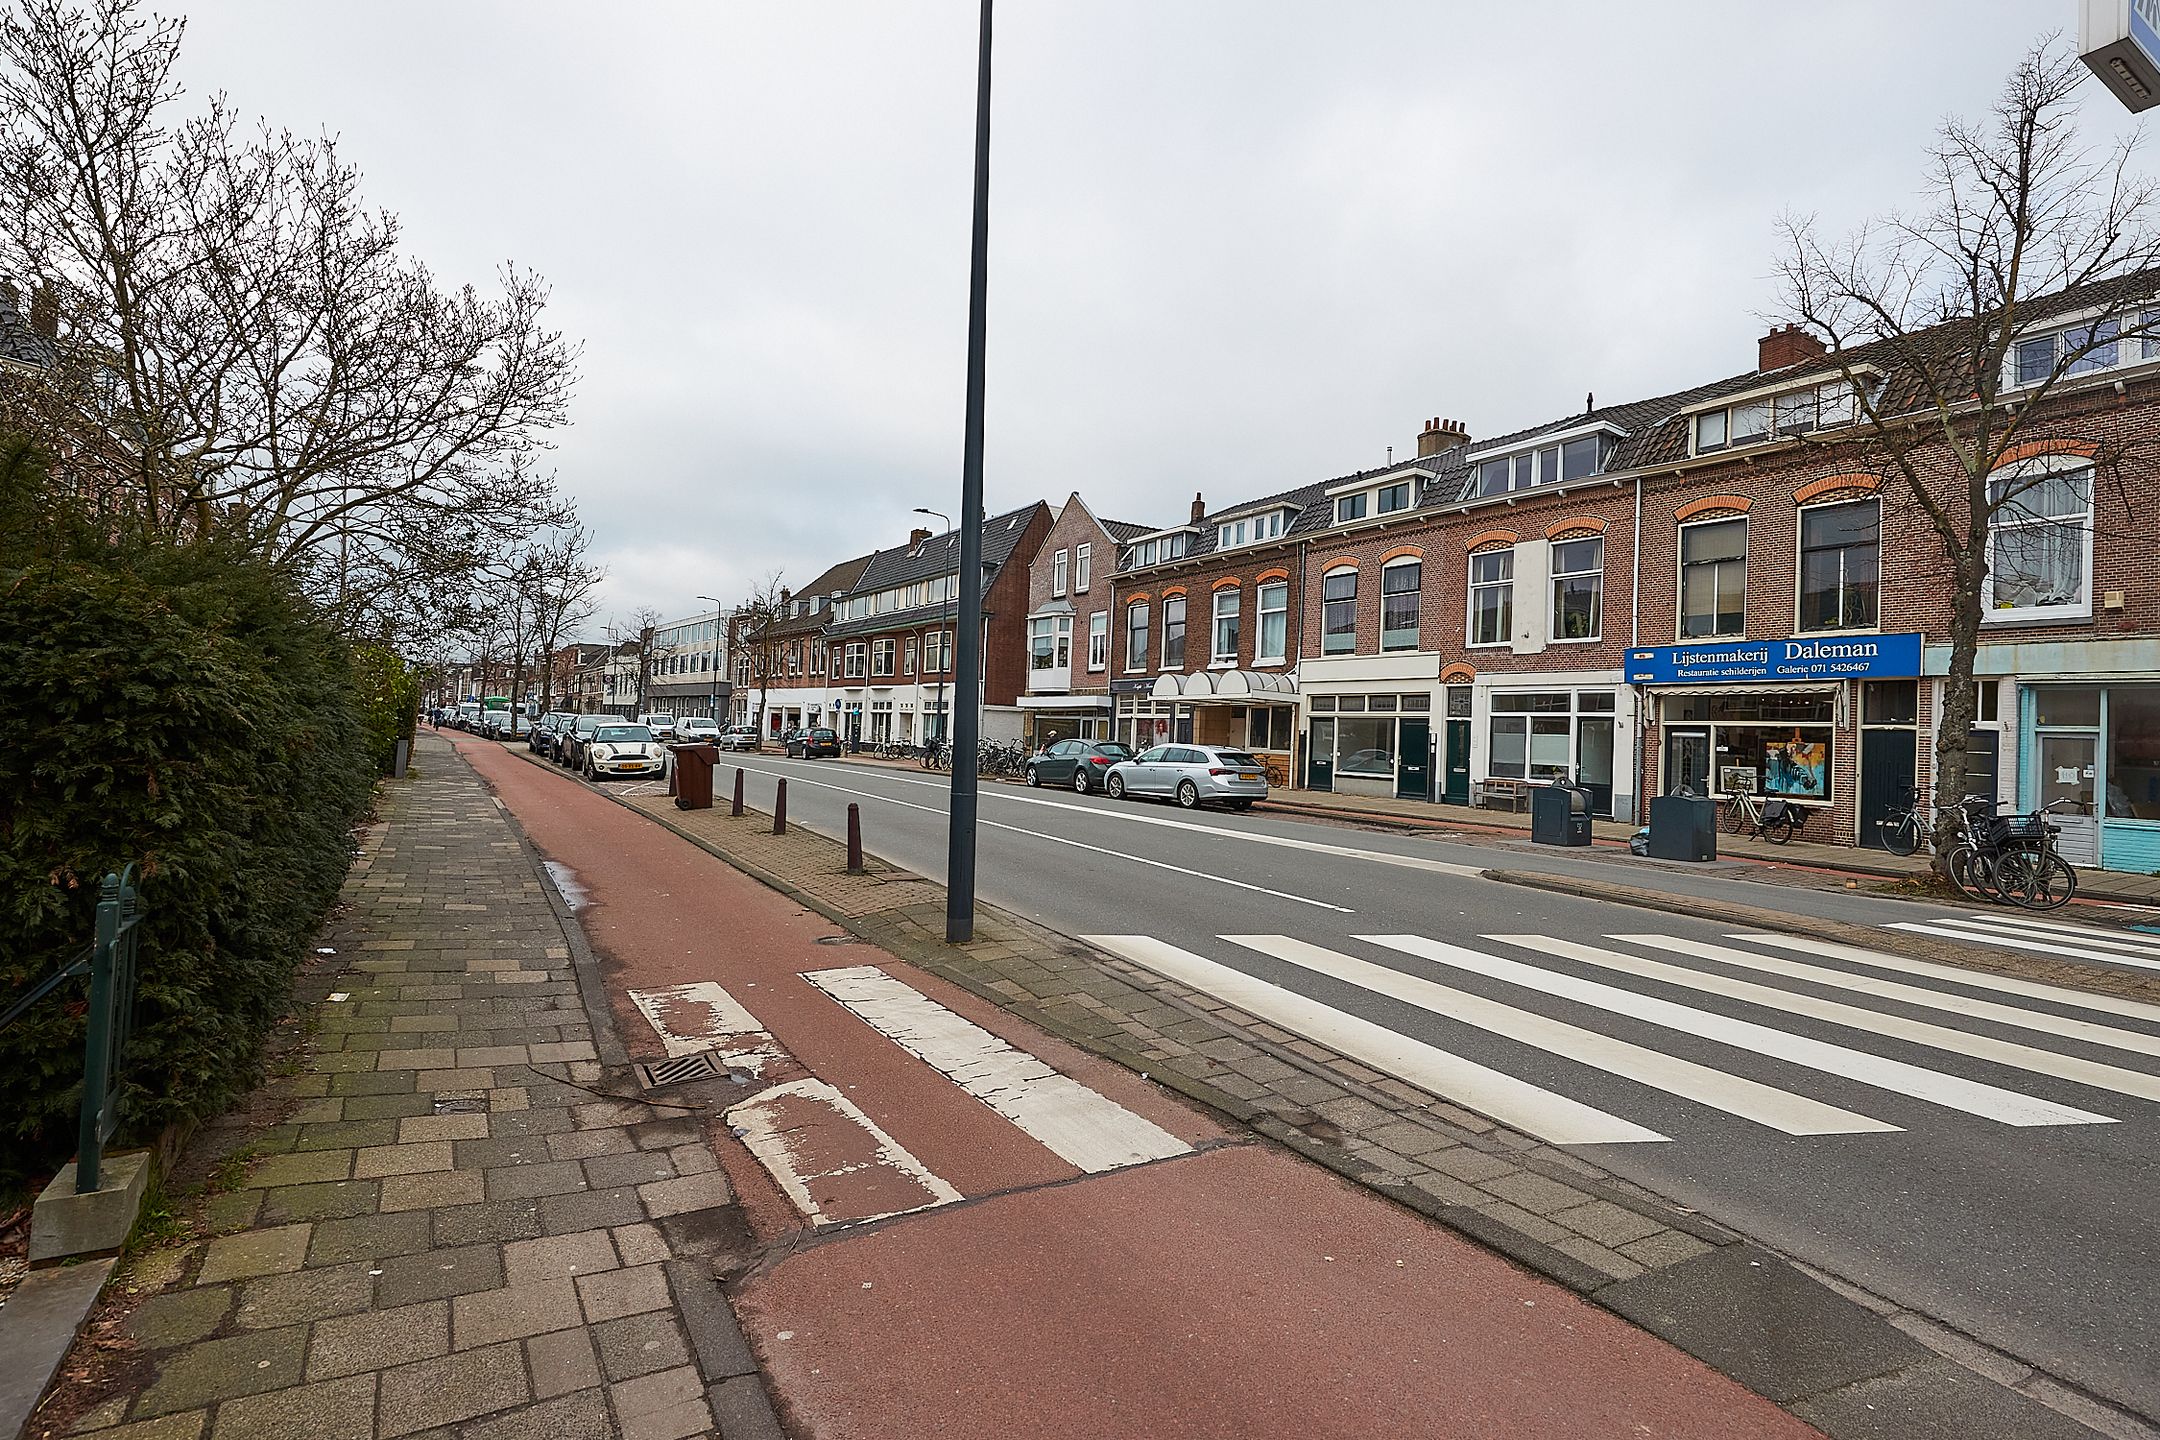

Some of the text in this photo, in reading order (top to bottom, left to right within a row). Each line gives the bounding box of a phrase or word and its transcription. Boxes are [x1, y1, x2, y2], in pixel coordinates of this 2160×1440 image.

[1672, 641, 1879, 666] Lijstenmakerij Daleman
[1677, 662, 1870, 677] Restauratie schilderijen Galerie 071 5426467
